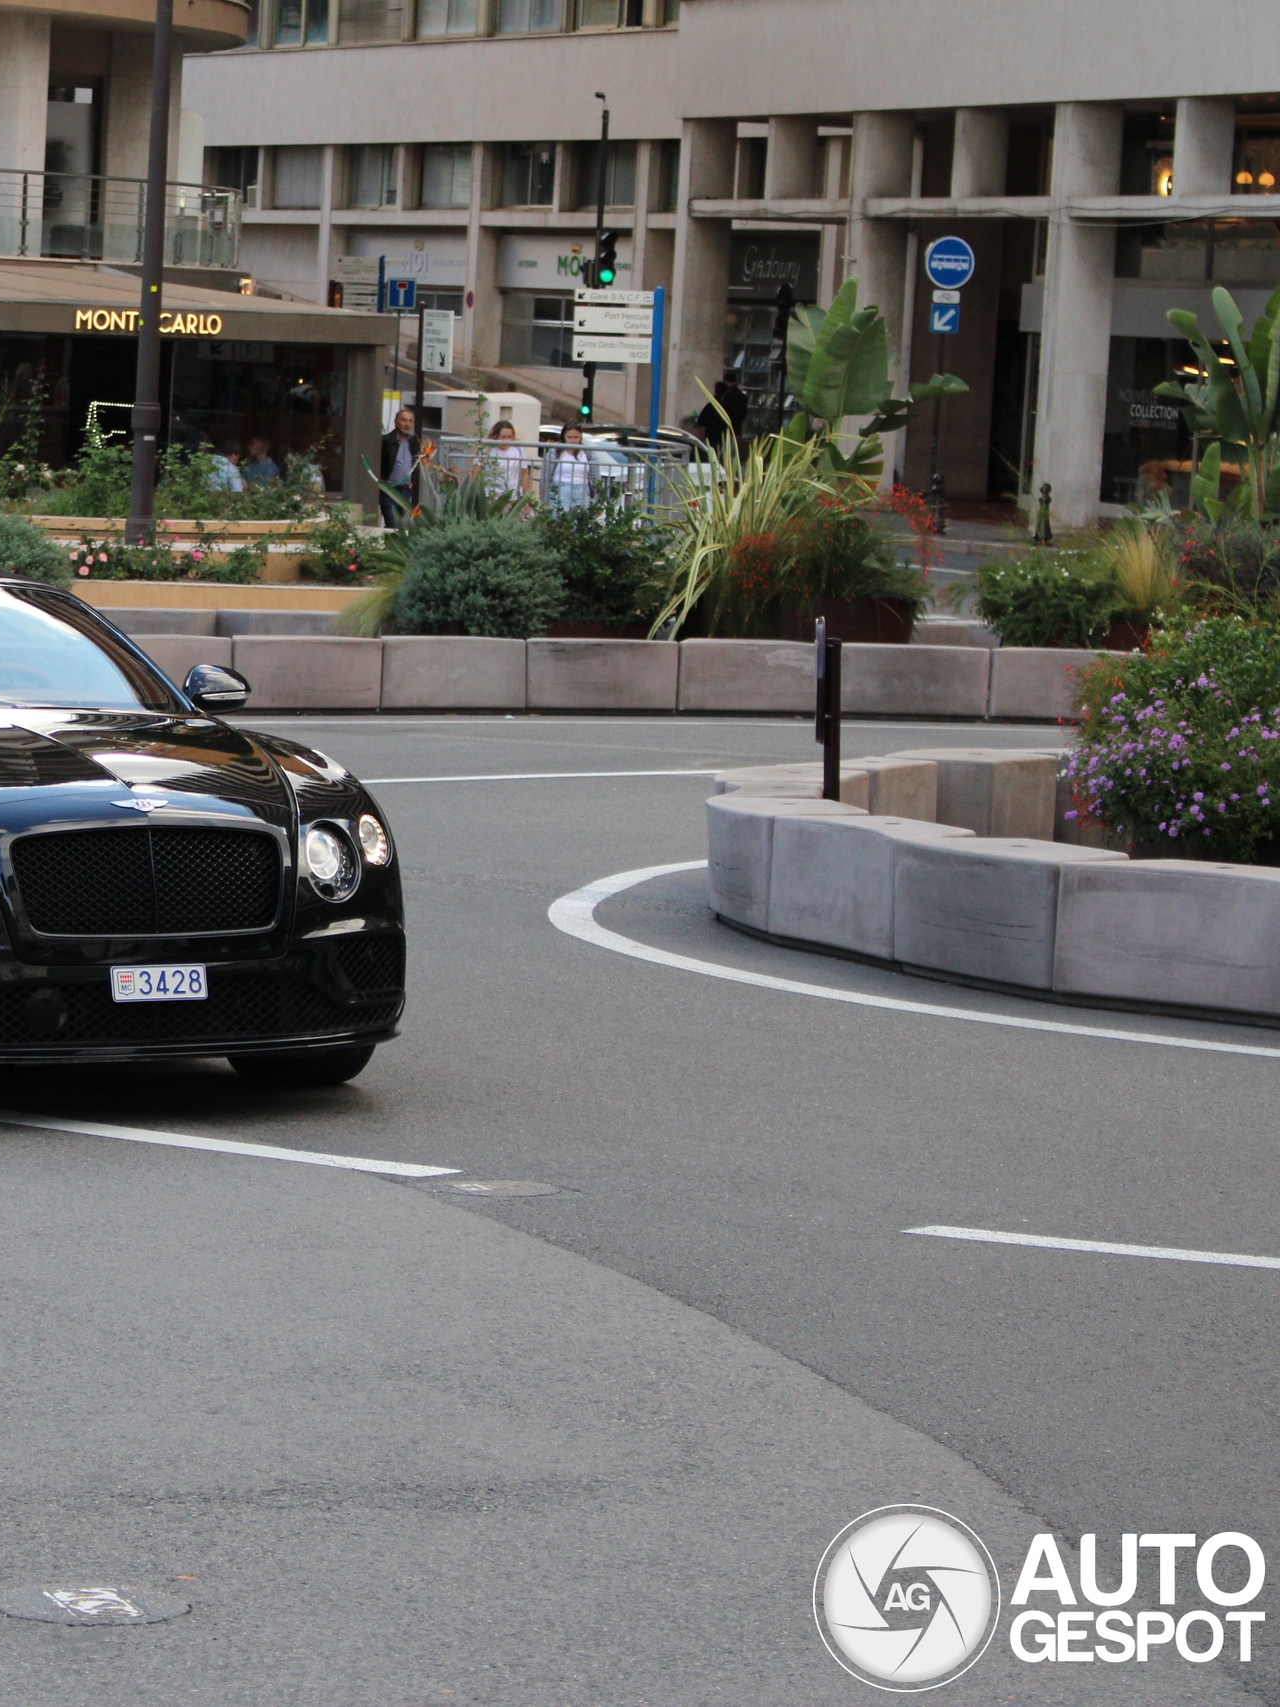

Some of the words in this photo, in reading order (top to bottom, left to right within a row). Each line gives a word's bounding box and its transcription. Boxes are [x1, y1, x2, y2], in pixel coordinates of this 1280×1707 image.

[590, 292, 609, 301] Gare
[75, 309, 140, 332] MONT
[604, 311, 620, 320] Port
[621, 312, 651, 321] Hercule
[624, 321, 651, 330] Casino
[1130, 403, 1179, 420] COLLECTION
[120, 984, 133, 992] MC
[138, 969, 202, 996] 3428
